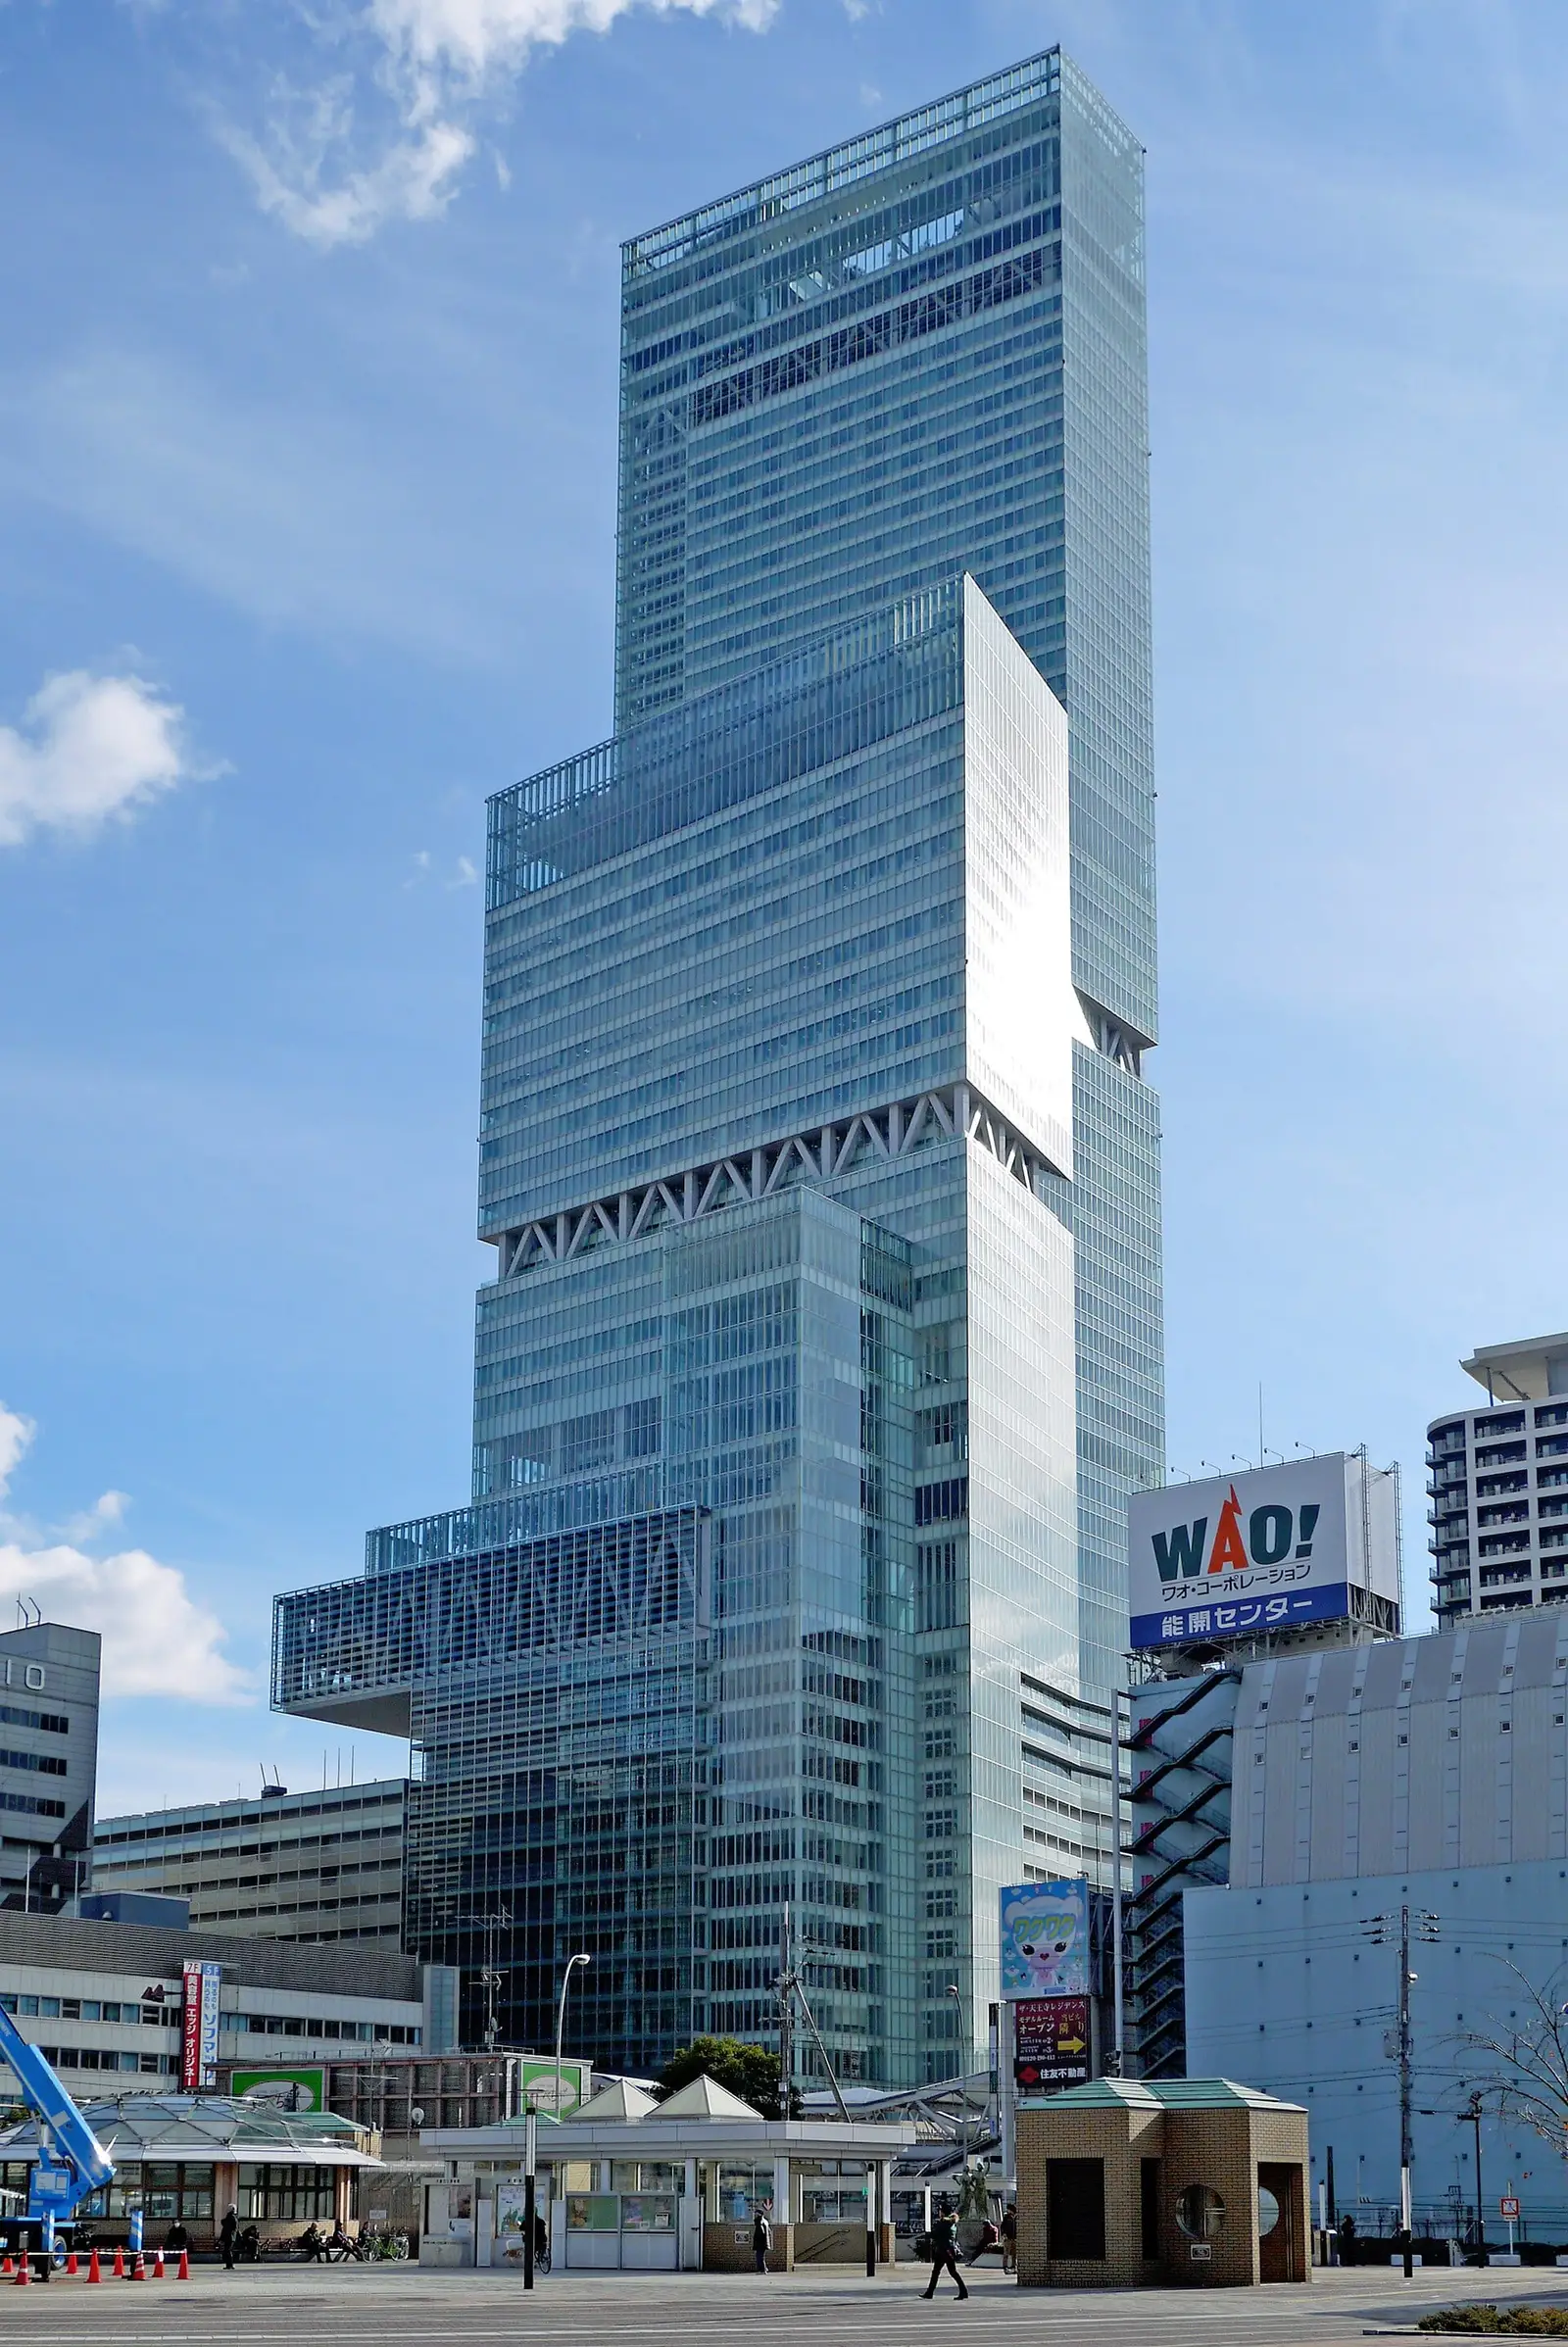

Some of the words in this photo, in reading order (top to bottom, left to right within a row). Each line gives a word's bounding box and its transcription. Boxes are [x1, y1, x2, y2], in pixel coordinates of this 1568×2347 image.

[1152, 1484, 1320, 1582] WAO!
[1161, 1564, 1311, 1601] ワオ・コーポレーション
[1161, 1597, 1312, 1638] 能開センター
[1014, 1915, 1076, 1942] ワクワク
[187, 1963, 199, 1973] 7F
[206, 1966, 220, 1975] 5F
[186, 2008, 197, 2034] エッジ
[1019, 2023, 1055, 2034] オープン
[1040, 2067, 1086, 2079] 住友不動産
